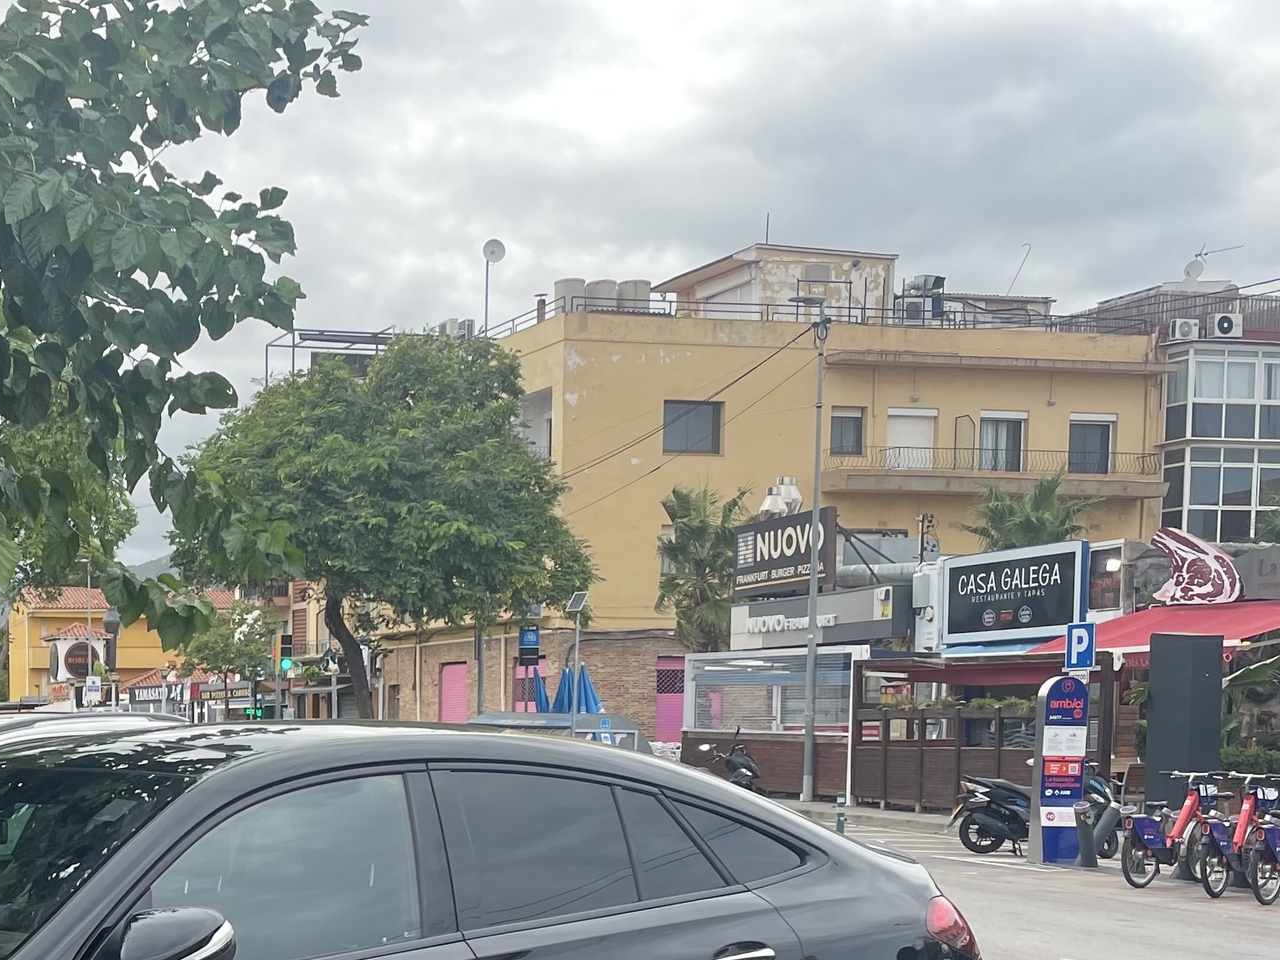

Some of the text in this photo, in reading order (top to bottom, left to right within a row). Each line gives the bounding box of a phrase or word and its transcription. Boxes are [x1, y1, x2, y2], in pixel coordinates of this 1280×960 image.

[756, 522, 825, 562] NUOVO
[736, 570, 769, 585] FRANKFURT
[771, 566, 795, 580] BURGER
[958, 562, 1061, 595] CASA GALEGA
[971, 592, 1015, 603] RESTAURANTE
[1024, 588, 1046, 599] TAPAS
[746, 614, 785, 634] NUOVO
[1070, 628, 1090, 665] P
[1050, 698, 1084, 709] ambici
